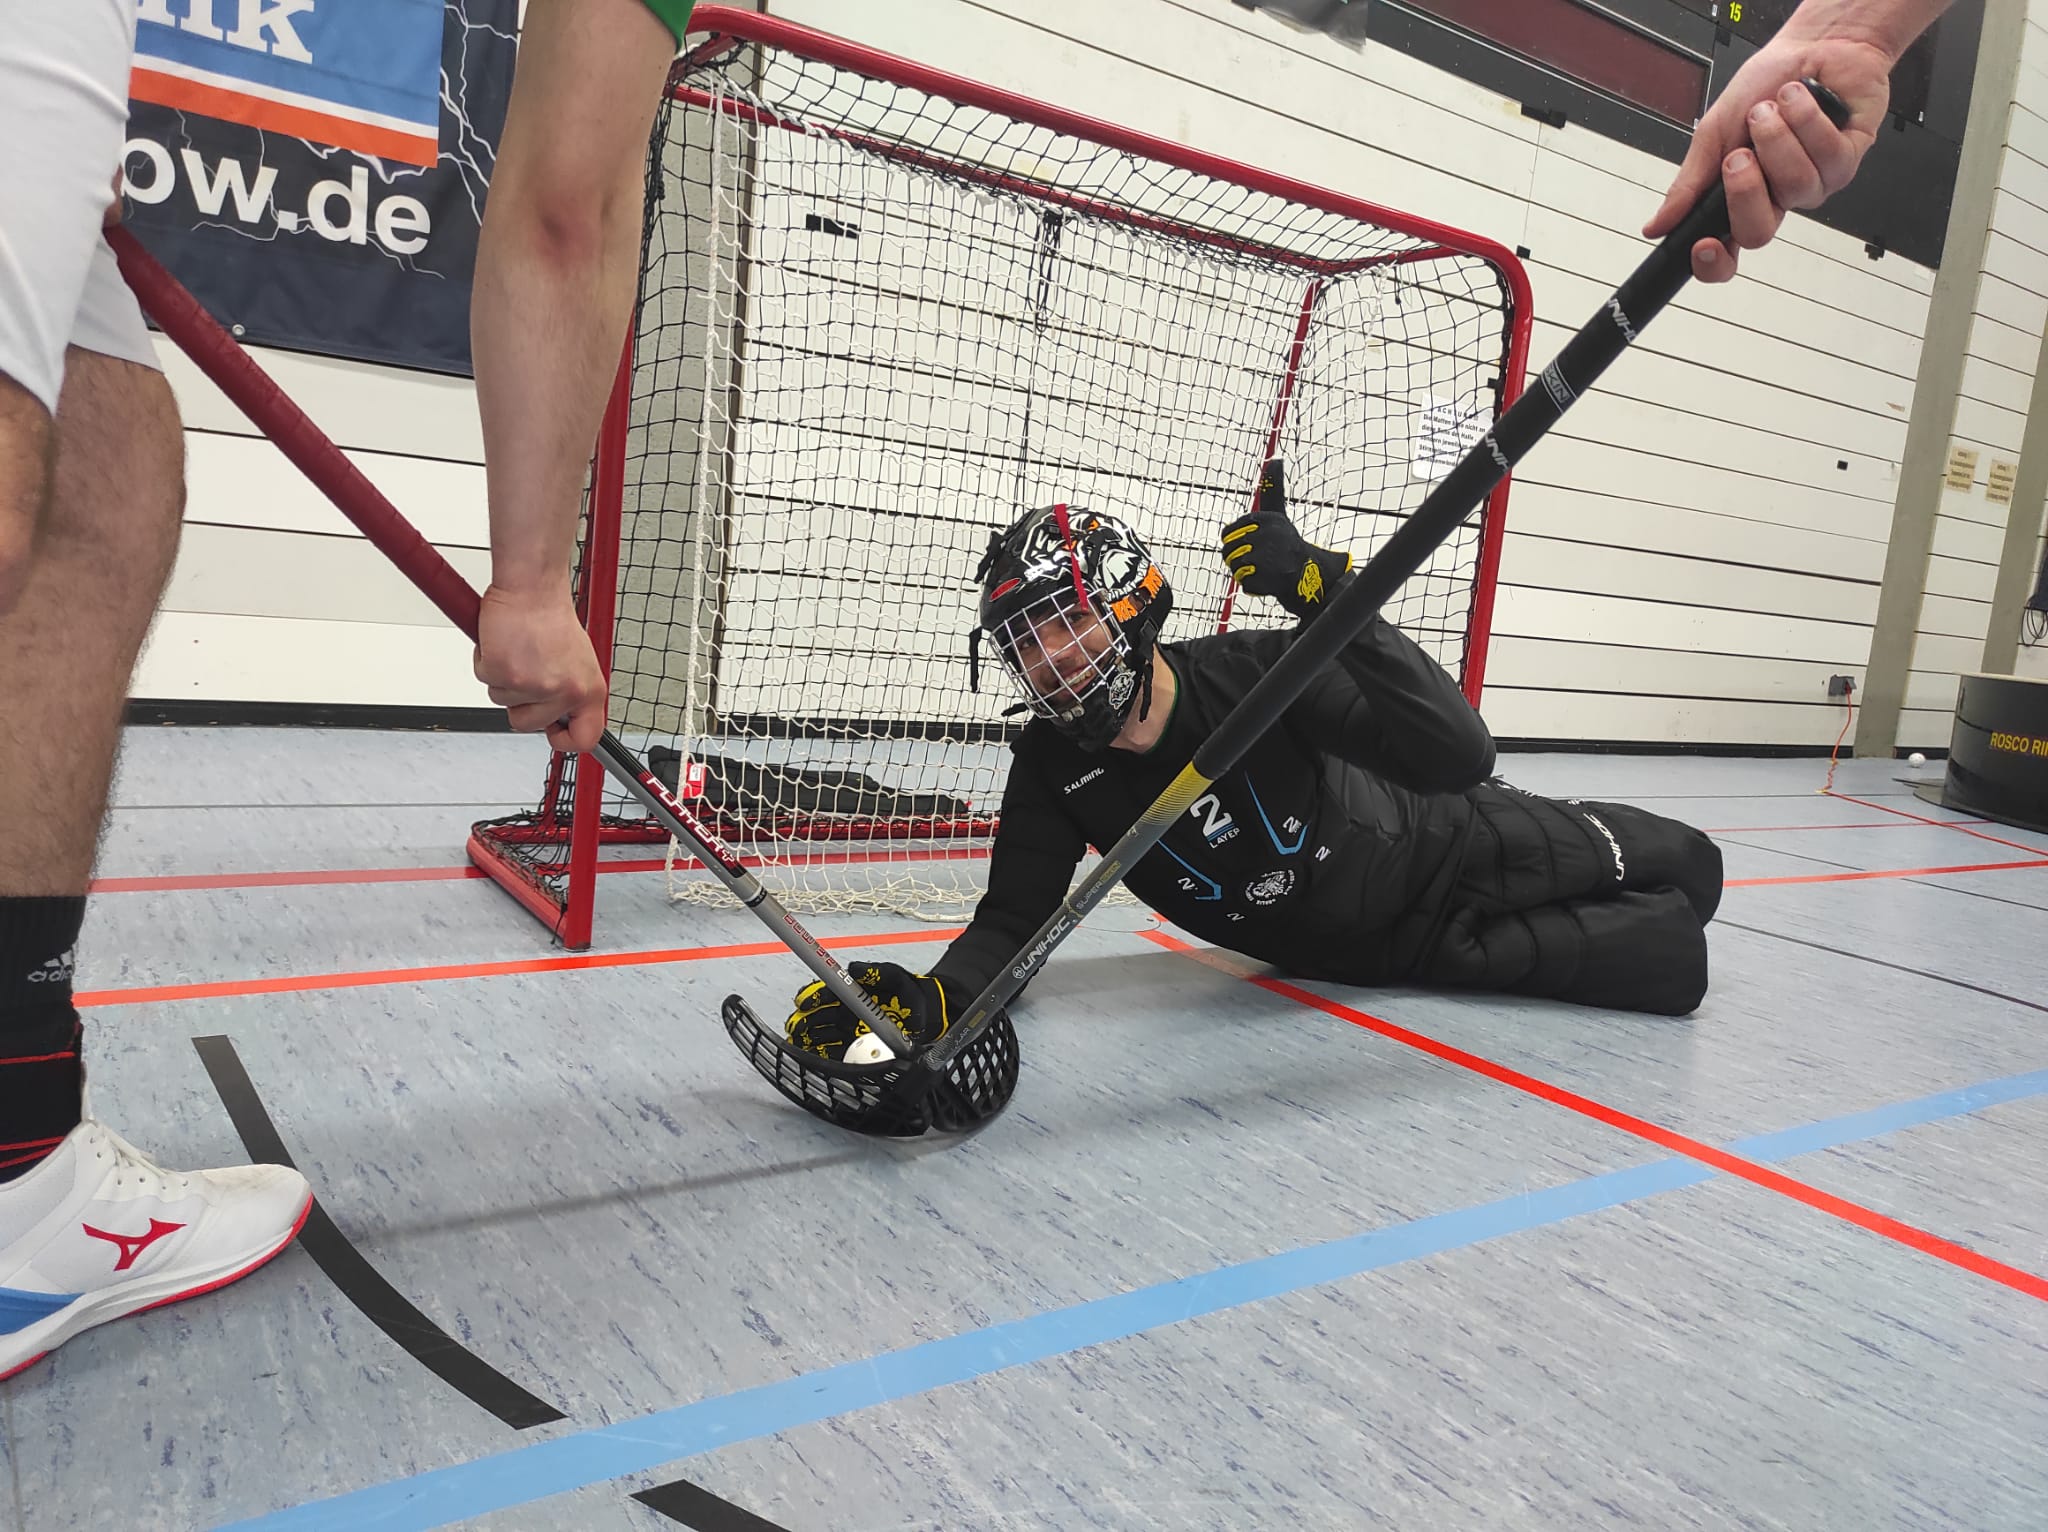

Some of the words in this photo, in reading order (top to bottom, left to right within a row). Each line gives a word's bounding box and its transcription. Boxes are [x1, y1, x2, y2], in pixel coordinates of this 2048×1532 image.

[1729, 1, 1743, 23] 15
[1990, 732, 2030, 752] ROSCO
[1064, 768, 1105, 795] SALMING
[1190, 793, 1233, 837] 2
[1020, 914, 1070, 971] UNIHOC
